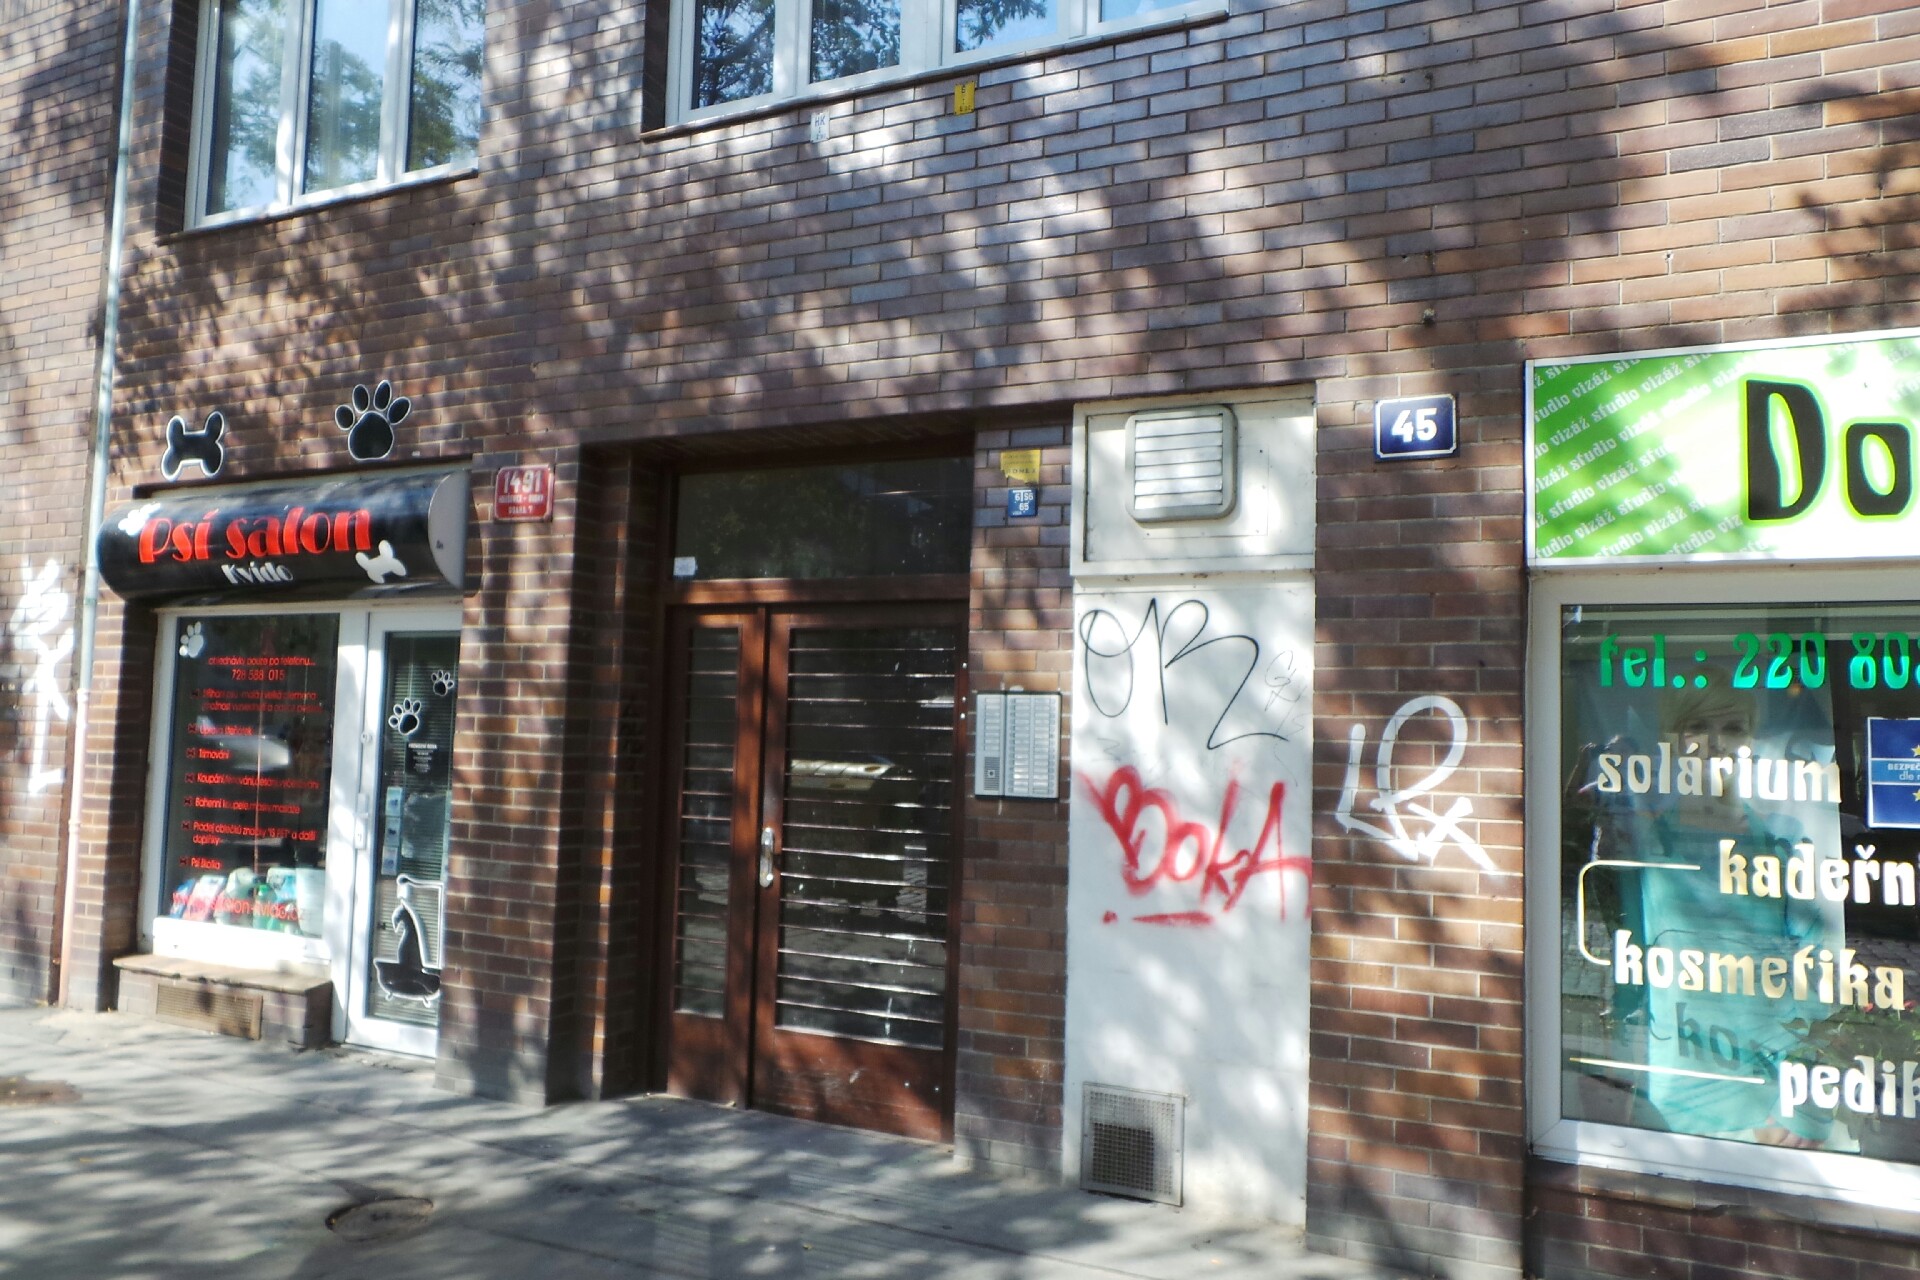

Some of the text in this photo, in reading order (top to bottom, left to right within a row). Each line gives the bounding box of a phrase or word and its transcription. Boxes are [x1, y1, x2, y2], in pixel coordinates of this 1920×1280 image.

[1550, 415, 1591, 447] vizáž
[1590, 387, 1641, 424] studio
[1640, 361, 1684, 394] vizáž
[1571, 367, 1613, 399] vizáž
[1391, 407, 1438, 443] 45
[1568, 437, 1618, 472] studio
[503, 470, 542, 494] 1491
[1548, 484, 1596, 520] studio
[1595, 459, 1639, 492] vizáž
[226, 506, 373, 559] salon
[1574, 507, 1616, 540] vizáž
[1616, 482, 1667, 516] studio
[1643, 503, 1688, 537] vizáž
[221, 561, 295, 585] Kvido
[1731, 632, 1827, 689] 220
[1849, 631, 1920, 689] 80
[1597, 742, 1842, 803] solárium
[1899, 771, 1914, 781] dle
[1718, 839, 1920, 906] kadeřn
[1613, 929, 1905, 1011] kosmetika
